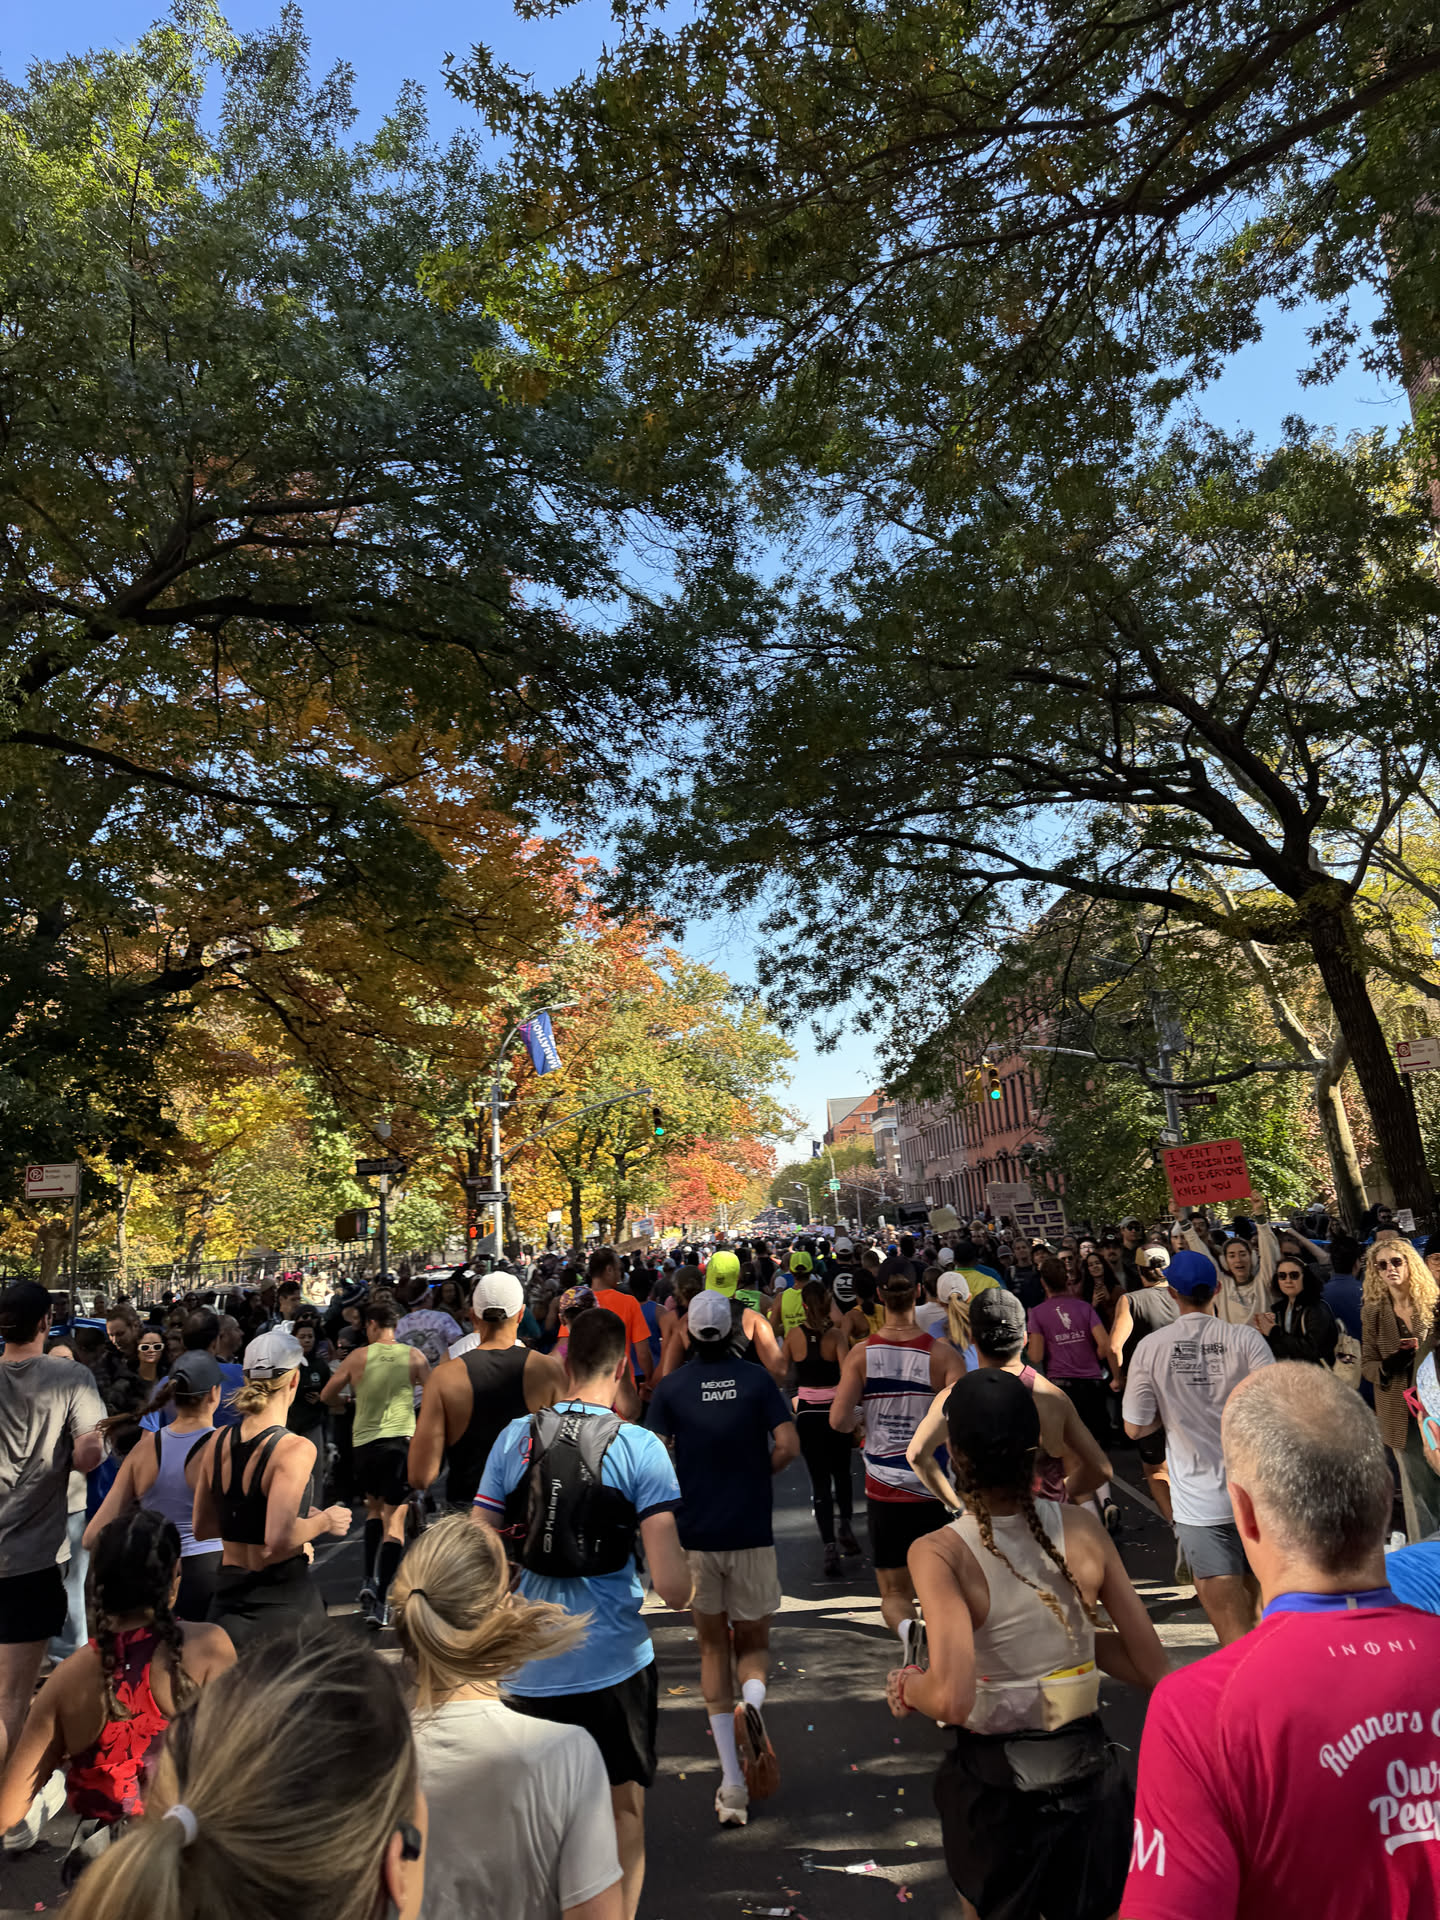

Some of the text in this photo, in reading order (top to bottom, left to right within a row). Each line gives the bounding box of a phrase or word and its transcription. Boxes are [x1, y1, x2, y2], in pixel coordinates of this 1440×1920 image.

[1167, 1144, 1232, 1163] I WENT TO
[1168, 1155, 1243, 1172] THE FINISH LINE
[1173, 1166, 1244, 1184] AND EVERYONE
[1177, 1180, 1232, 1197] KNEW YOU
[1055, 1333, 1070, 1342] RUN
[702, 1389, 737, 1401] DAVID
[1319, 1711, 1424, 1777] Runners
